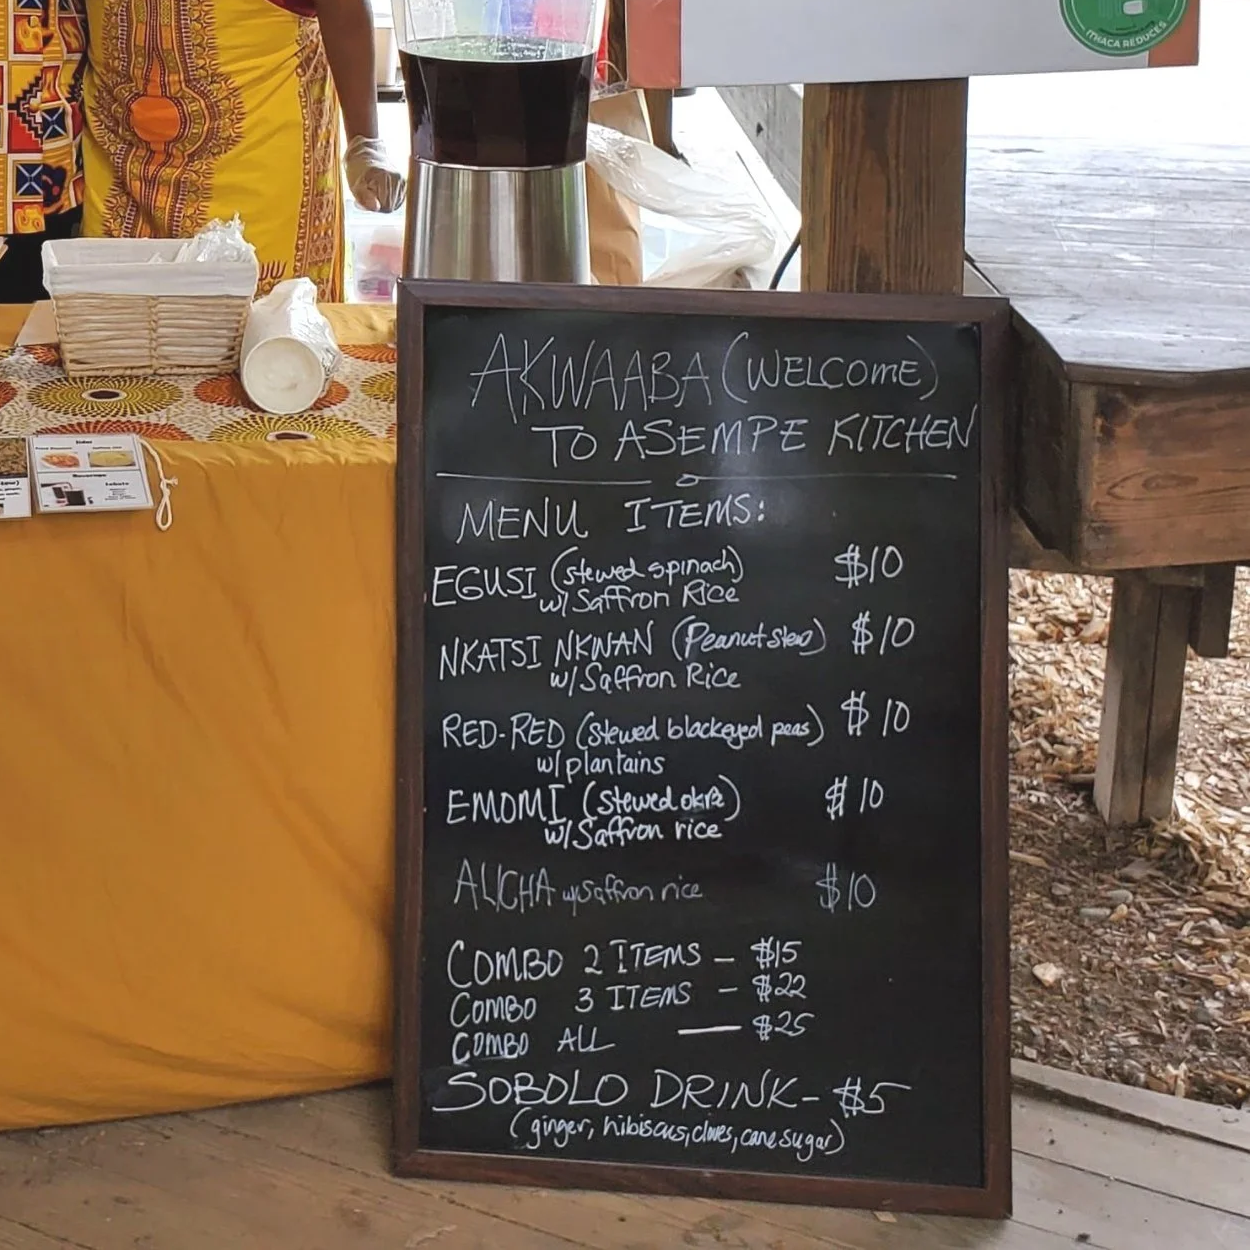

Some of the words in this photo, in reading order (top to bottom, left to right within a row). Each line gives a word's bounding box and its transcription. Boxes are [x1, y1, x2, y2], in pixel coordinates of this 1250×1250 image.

[1086, 29, 1121, 48] ITHACA
[1122, 20, 1168, 48] REDUCES
[470, 332, 711, 423] AKWAABA
[531, 424, 598, 467] TO
[614, 414, 808, 462] ASEMPE
[827, 403, 978, 456] KITCHEN
[456, 497, 589, 544] MENU
[624, 493, 766, 534] ITEMS:
[432, 565, 538, 607] EGUSI
[834, 543, 904, 589] $10
[682, 578, 741, 608] Rice
[439, 635, 543, 681] NKATSI
[553, 620, 654, 668] NKWAN
[851, 610, 915, 656] $10
[685, 661, 742, 689] Rice
[442, 711, 566, 751] RED-RED
[667, 714, 763, 750] blackeyed
[446, 783, 568, 825] EMOMI
[675, 819, 723, 840] rice
[661, 875, 704, 901] rice
[816, 862, 877, 914] $10
[447, 939, 564, 989] COMBO
[583, 945, 603, 975] 2
[609, 939, 702, 975] ITEMS
[751, 936, 803, 969] $15
[450, 991, 537, 1028] COMBO
[574, 988, 594, 1013] 3
[606, 982, 693, 1011] ITEMS
[752, 972, 807, 1002] $22
[452, 1032, 529, 1065] COMBO
[557, 1025, 617, 1053] ALL
[752, 1010, 815, 1042] $25
[432, 1070, 630, 1112] SOBOLO
[832, 1076, 912, 1120] $5
